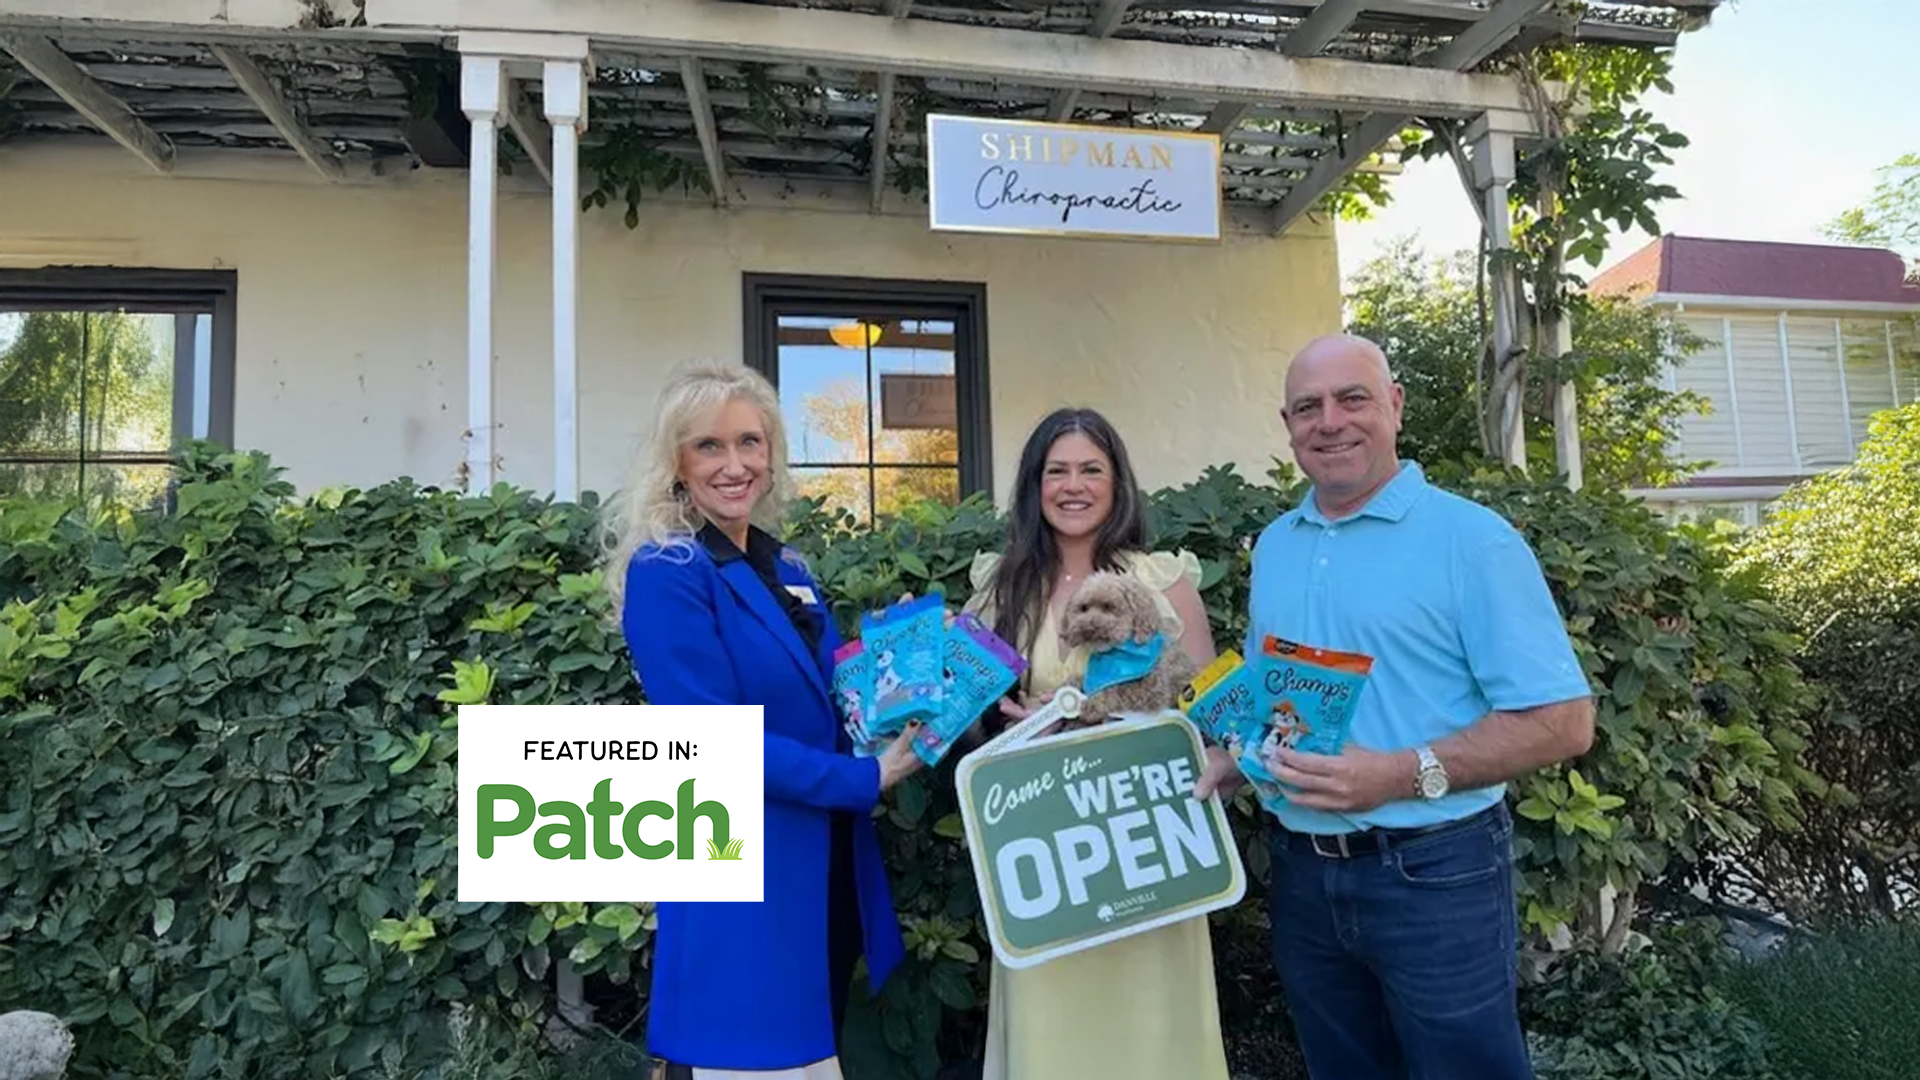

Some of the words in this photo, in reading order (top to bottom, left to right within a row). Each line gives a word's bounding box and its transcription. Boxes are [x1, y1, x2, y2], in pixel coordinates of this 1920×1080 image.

[980, 132, 1174, 171] SHIPMAN
[974, 165, 1183, 223] Chiropractic
[1198, 682, 1250, 733] hamp's
[1264, 667, 1349, 707] Champ's
[983, 772, 1056, 825] Come
[1063, 755, 1102, 780] in...
[1064, 757, 1195, 819] WE'RE
[995, 798, 1222, 920] OPEN
